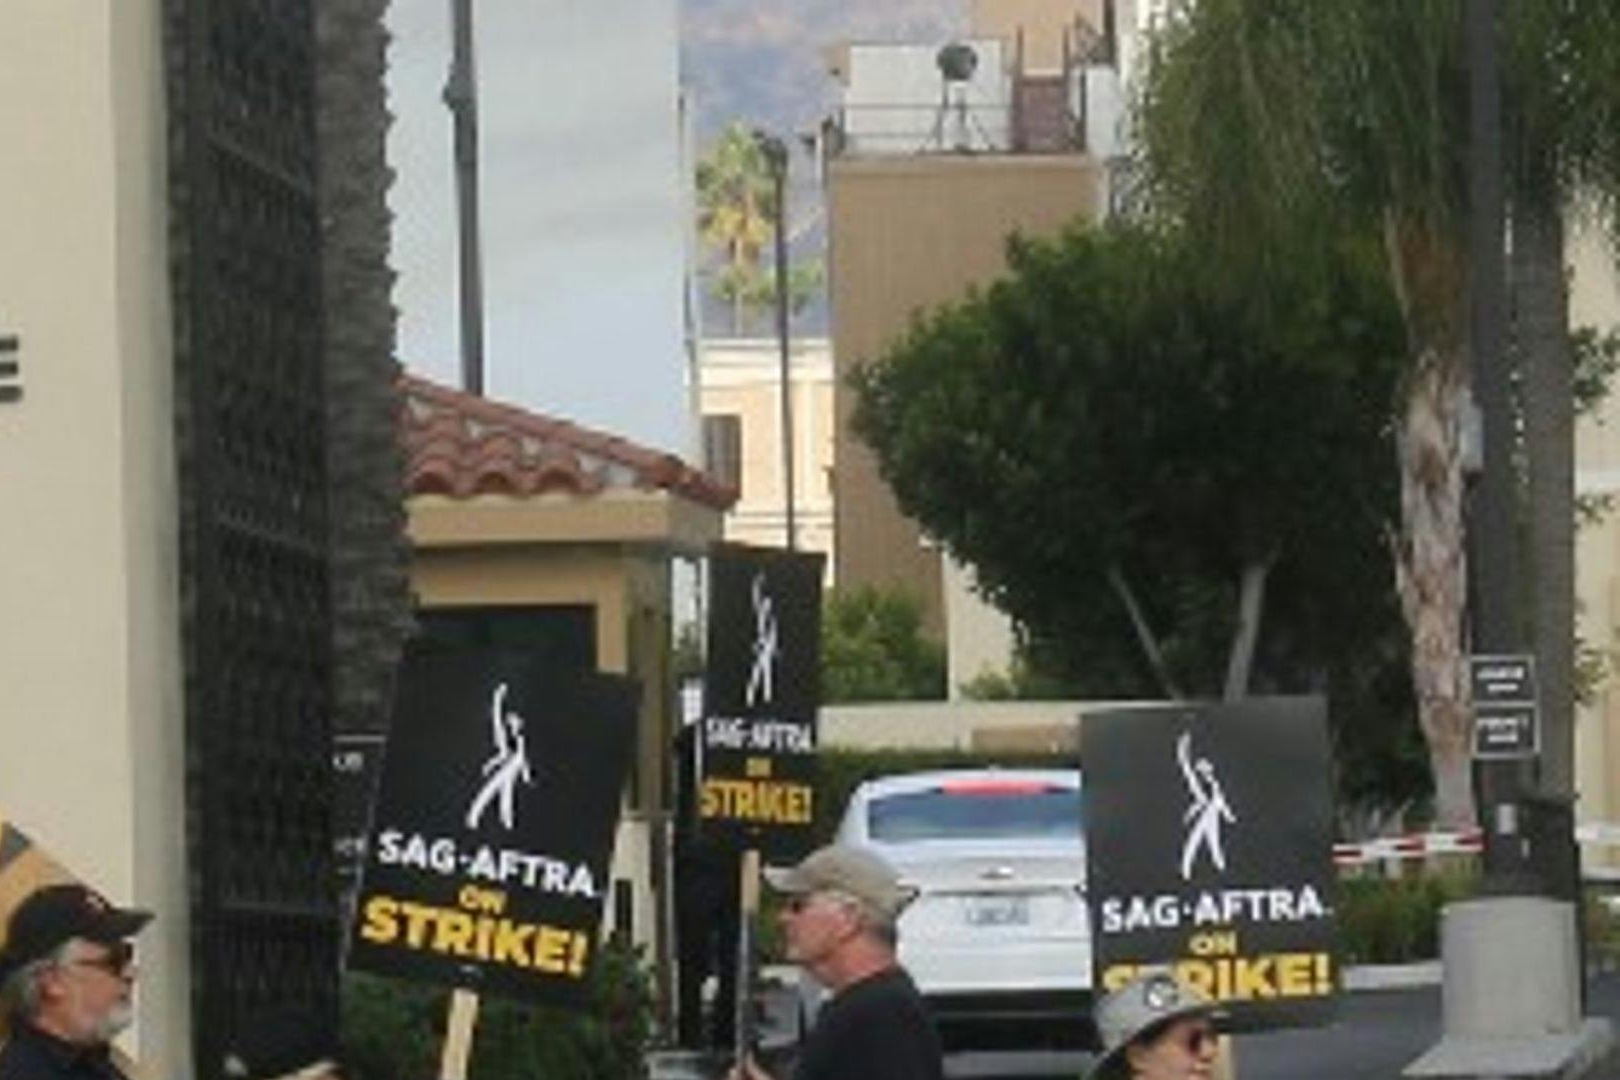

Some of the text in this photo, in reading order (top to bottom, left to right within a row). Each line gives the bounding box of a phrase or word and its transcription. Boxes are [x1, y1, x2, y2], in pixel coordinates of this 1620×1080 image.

[700, 781, 812, 824] STRIKE!
[458, 884, 507, 915] ON
[361, 897, 589, 977] STRIKE!
[1189, 930, 1237, 955] ON
